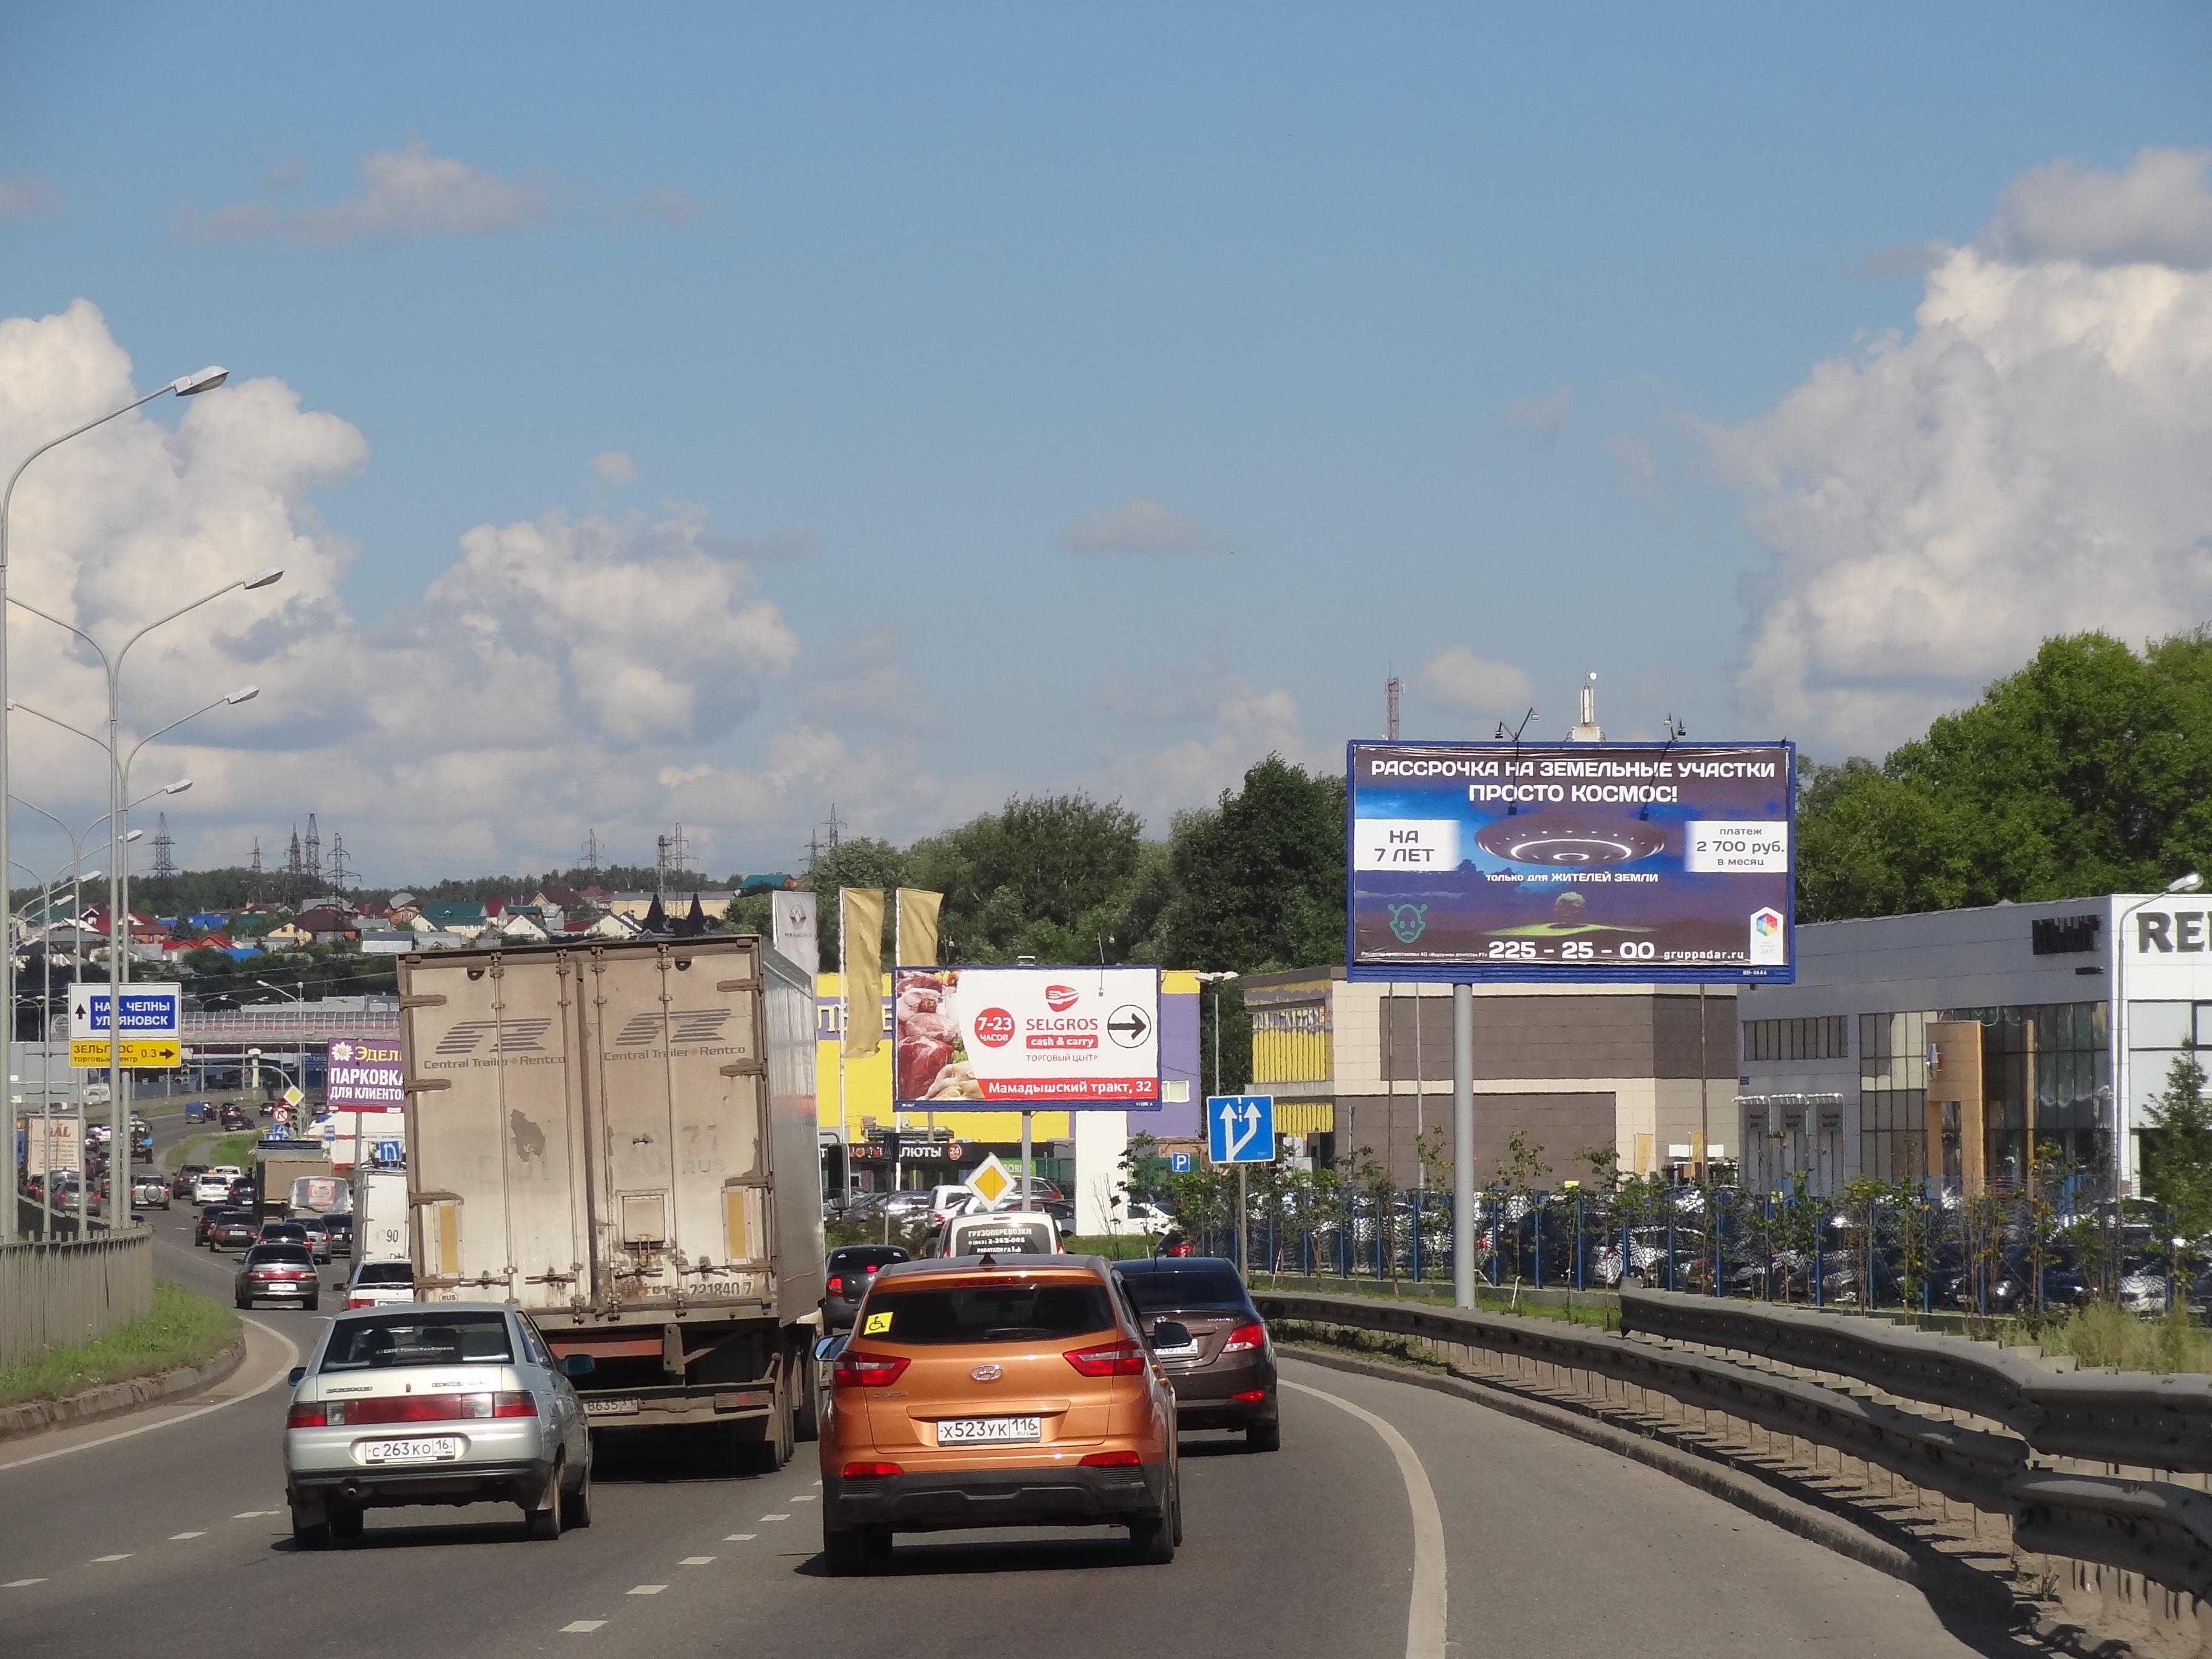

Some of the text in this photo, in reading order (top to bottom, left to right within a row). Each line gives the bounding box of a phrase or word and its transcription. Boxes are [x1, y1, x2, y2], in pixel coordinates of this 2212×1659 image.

[1371, 760, 1775, 778] РАССРОЧКА НА ЗЕМЕЛЬНЫЕ УЧАСТКИ
[1469, 784, 1678, 803] ПРОСТО КОСМОС!
[1389, 830, 1419, 844] НА
[1696, 840, 1785, 855] 2 700 руб.
[1374, 848, 1435, 862] 7 ЛЕТ
[1728, 859, 1765, 867] месяц
[1551, 871, 1612, 882] ЖИТЕЛЕЙ
[1614, 873, 1658, 882] ЗЕМЛИ
[2136, 911, 2212, 954] RE
[1489, 941, 1537, 959] 225
[1561, 942, 1594, 959] 25
[1620, 942, 1655, 959] 00
[1664, 950, 1744, 960] gruppadar.ru
[95, 1002, 170, 1011] НА. ЧЕЛНЫ
[95, 1016, 169, 1026] УЛЯНОВСК
[977, 1016, 1012, 1031] 7-23
[1025, 1018, 1098, 1031] SELGROS
[979, 1033, 1009, 1042] ЧАСОВ
[1031, 1036, 1094, 1048] cash & carry
[73, 1045, 157, 1058] ЗЕЛЬГОС 0.3
[604, 1046, 746, 1061] Central Trailer Rentco
[1026, 1053, 1099, 1063] ТОРГОВЫЙ ЦЕНТР
[424, 1059, 469, 1069] Central
[520, 1055, 566, 1065] Rentco
[330, 1087, 352, 1100] ДЛЯ
[989, 1081, 1152, 1095] Мамадышский тракт, 32
[386, 1229, 399, 1243] 90
[968, 1228, 1032, 1237] ГРУЗОПЕРЕВОЗКИ
[1011, 1418, 1036, 1431] 116
[435, 1439, 449, 1450] 16
